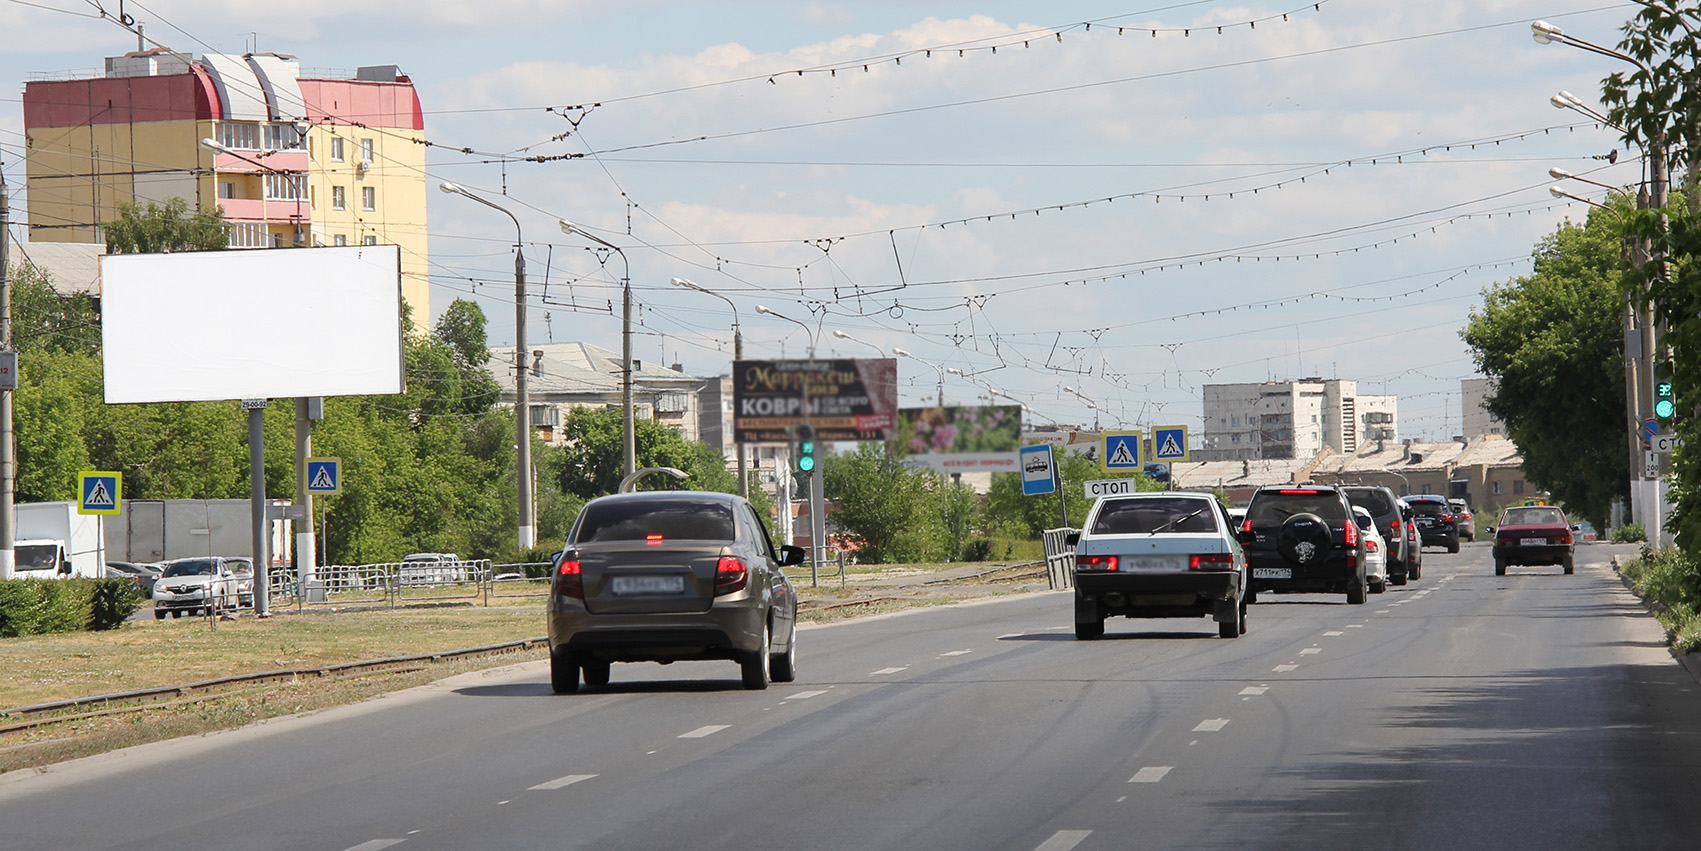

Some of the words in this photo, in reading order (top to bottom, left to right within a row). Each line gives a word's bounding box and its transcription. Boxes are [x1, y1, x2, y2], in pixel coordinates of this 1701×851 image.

[741, 397, 820, 416] КОВРЫ
[1646, 464, 1658, 472] 200
[1091, 481, 1129, 495] СТОП
